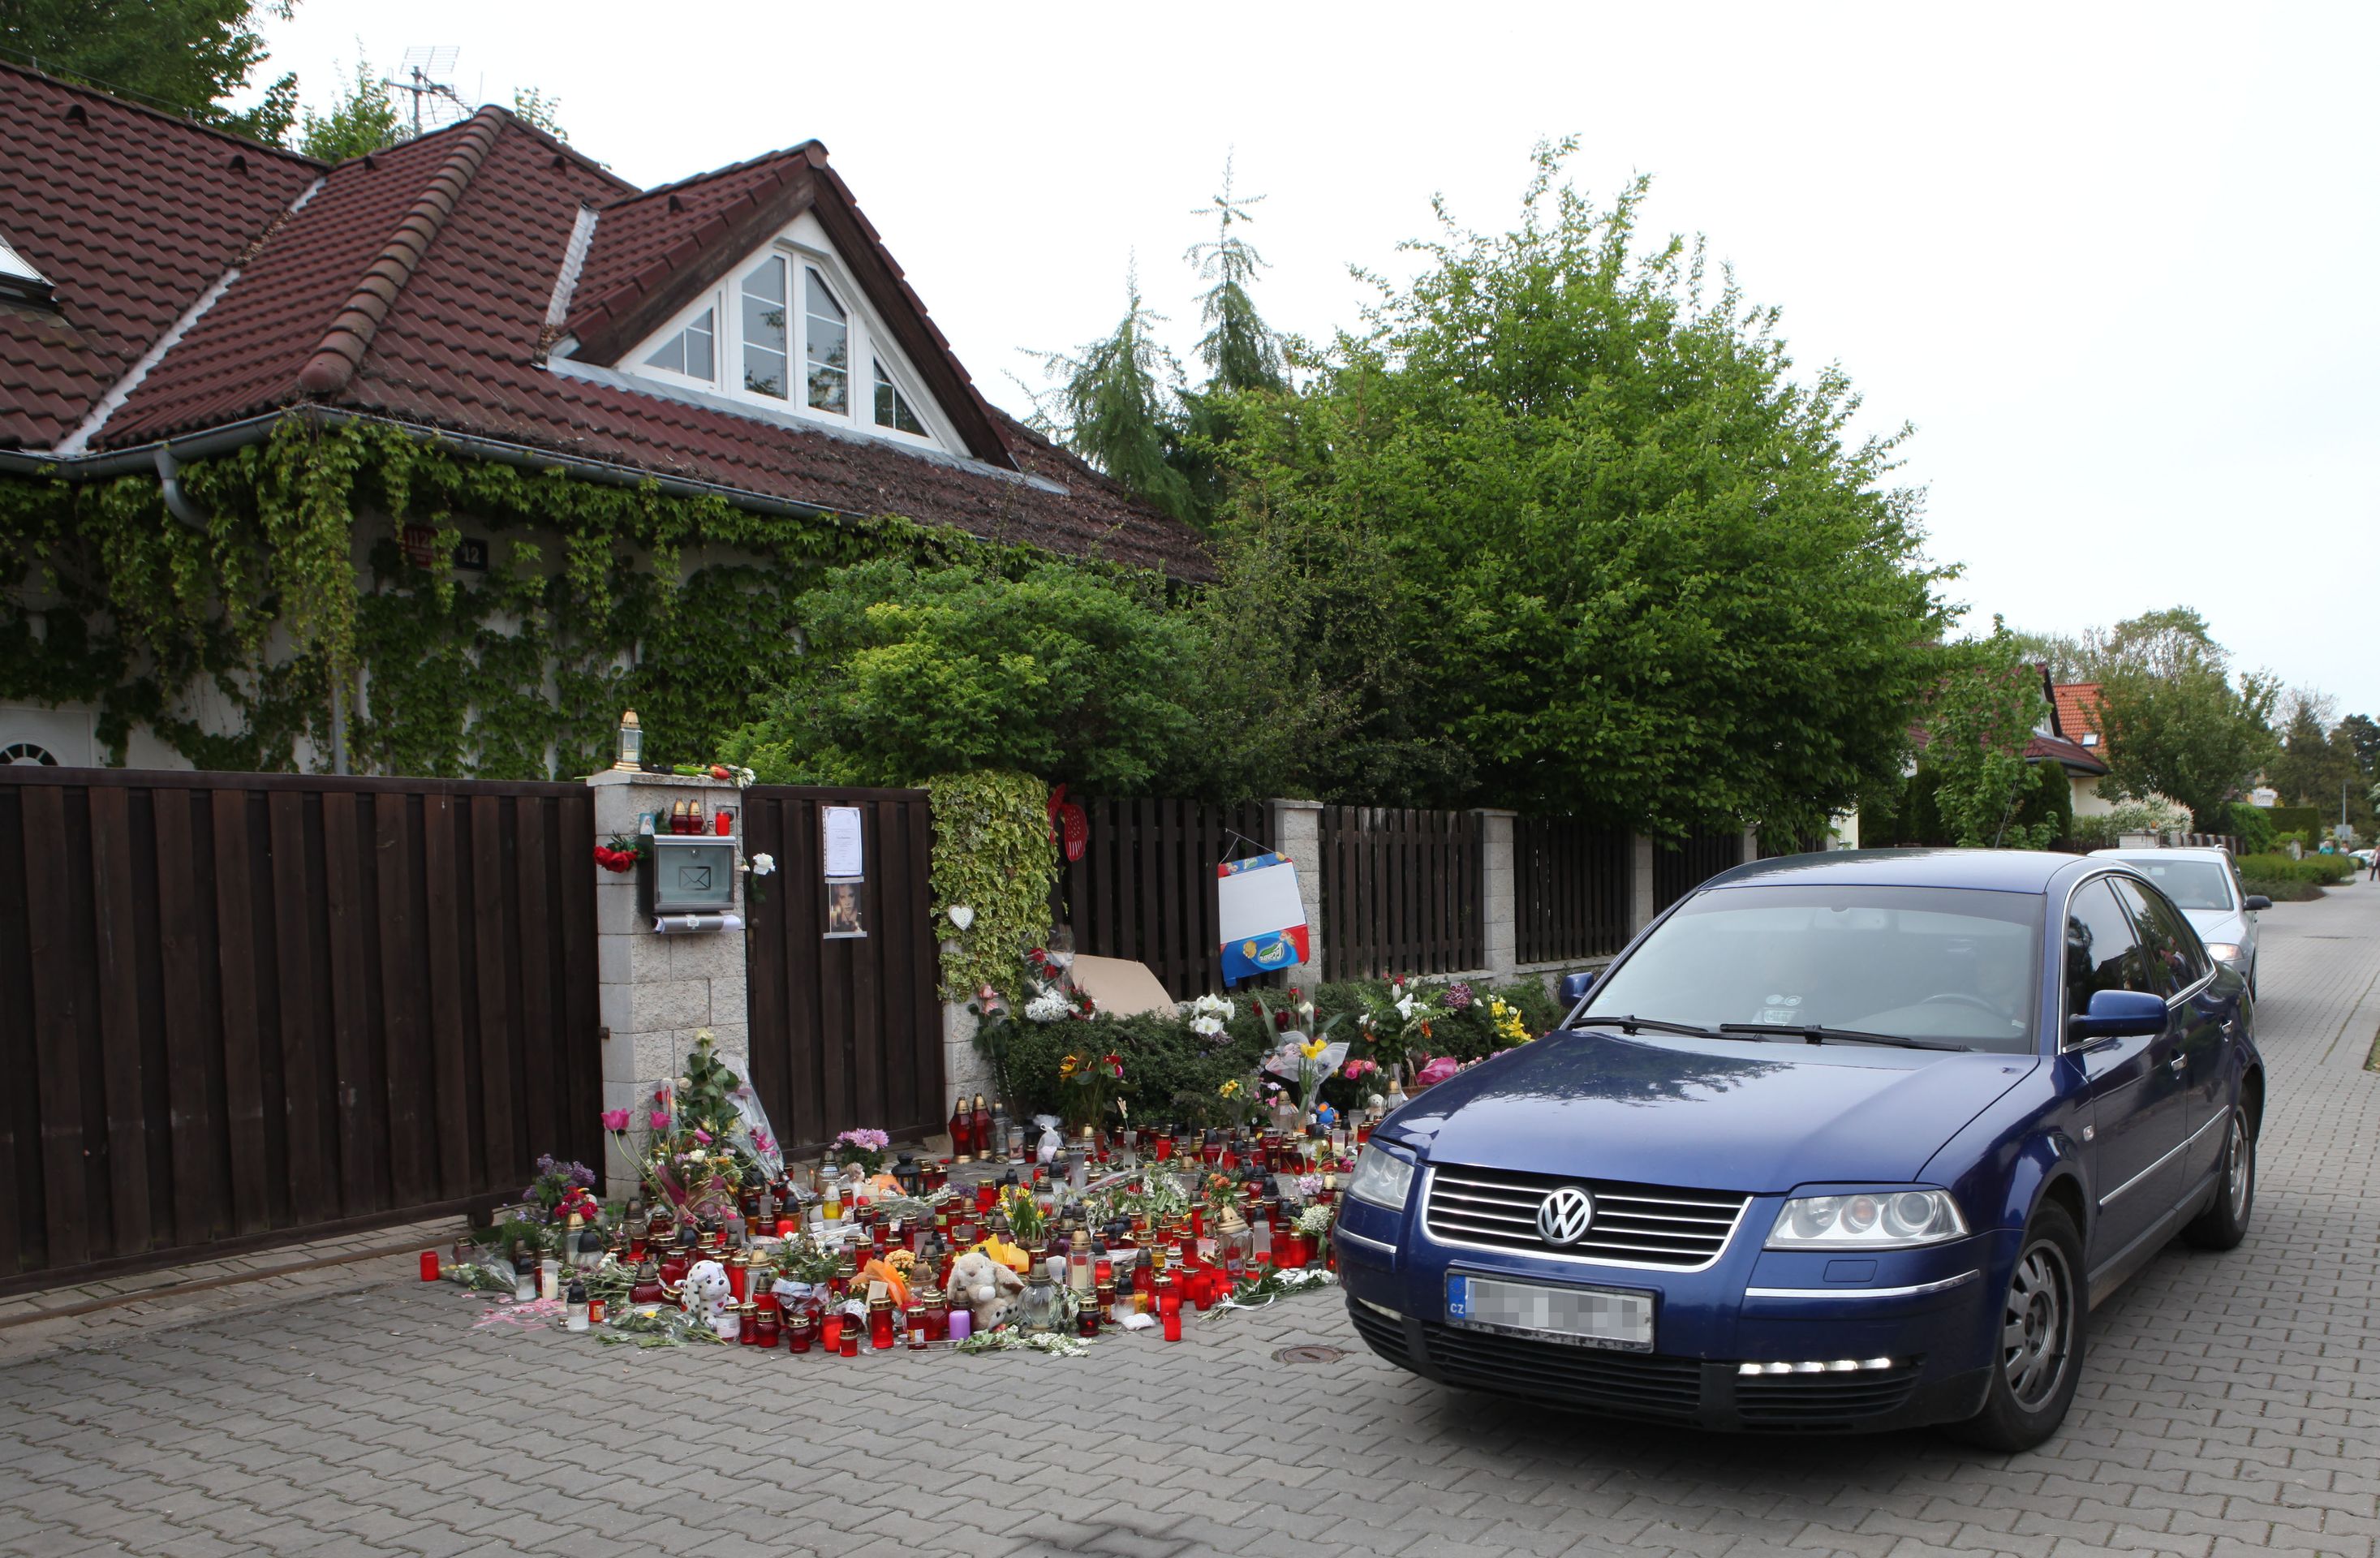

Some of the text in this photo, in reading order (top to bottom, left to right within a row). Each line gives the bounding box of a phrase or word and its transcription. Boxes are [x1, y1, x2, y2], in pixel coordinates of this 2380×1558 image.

[462, 544, 480, 564] 12
[1539, 1190, 1591, 1242] VW
[1450, 1303, 1465, 1315] CZ
